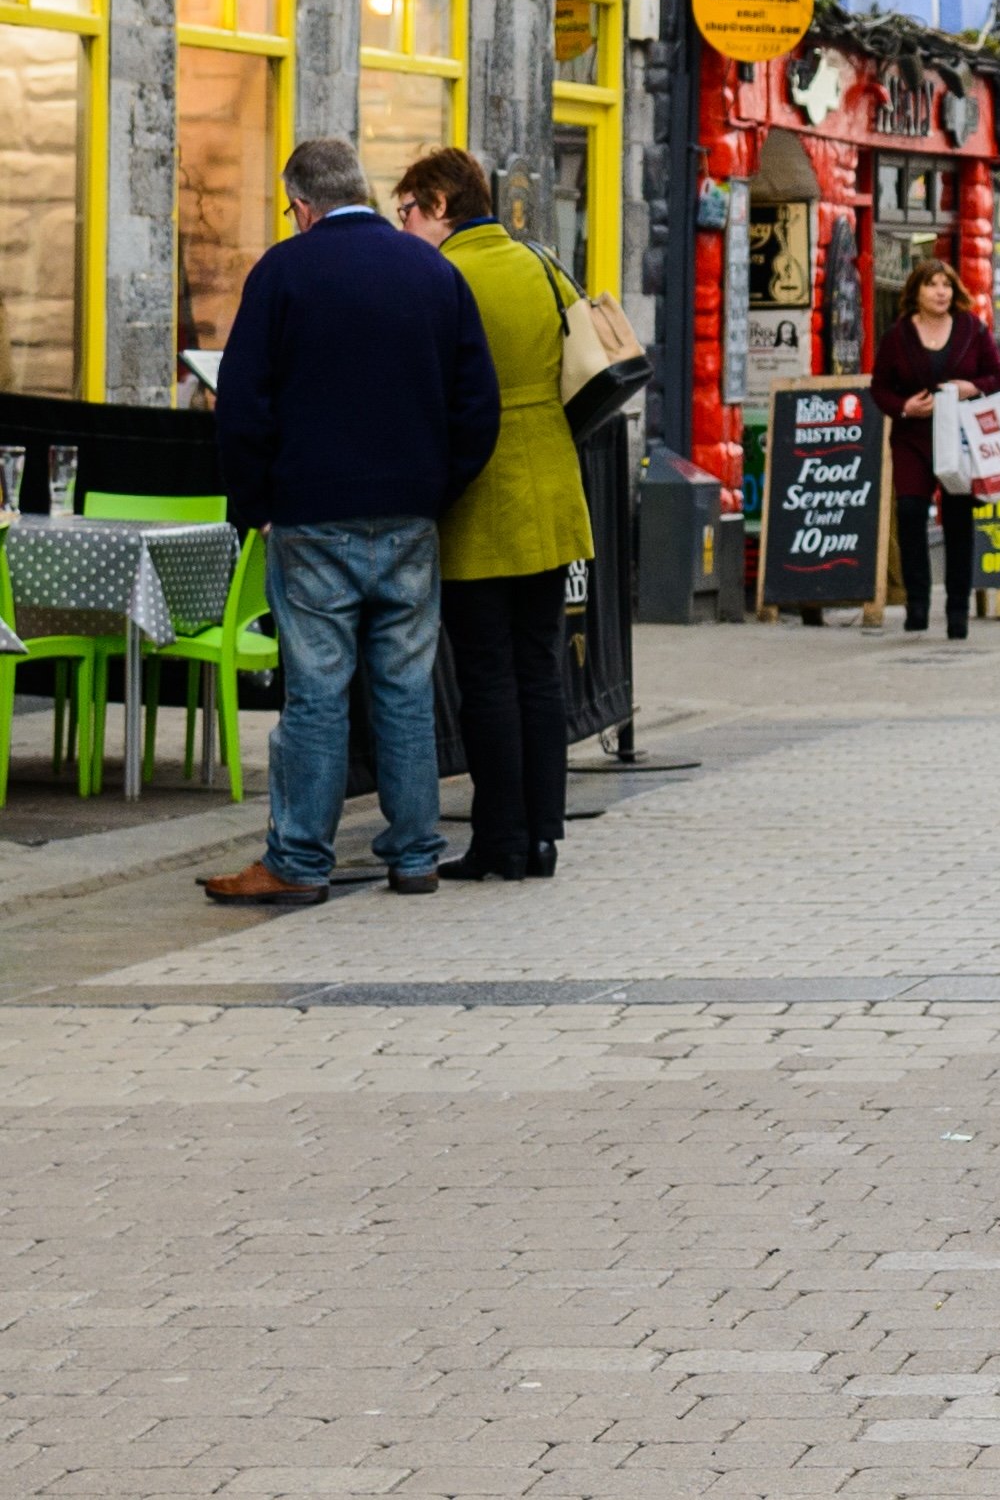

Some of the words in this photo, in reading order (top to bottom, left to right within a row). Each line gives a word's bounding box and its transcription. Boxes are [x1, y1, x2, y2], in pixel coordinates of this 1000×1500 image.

[795, 426, 862, 445] BISTRO
[797, 455, 862, 484] Food
[782, 481, 872, 511] Served
[803, 509, 844, 527] Until
[789, 527, 860, 558] 10pm
